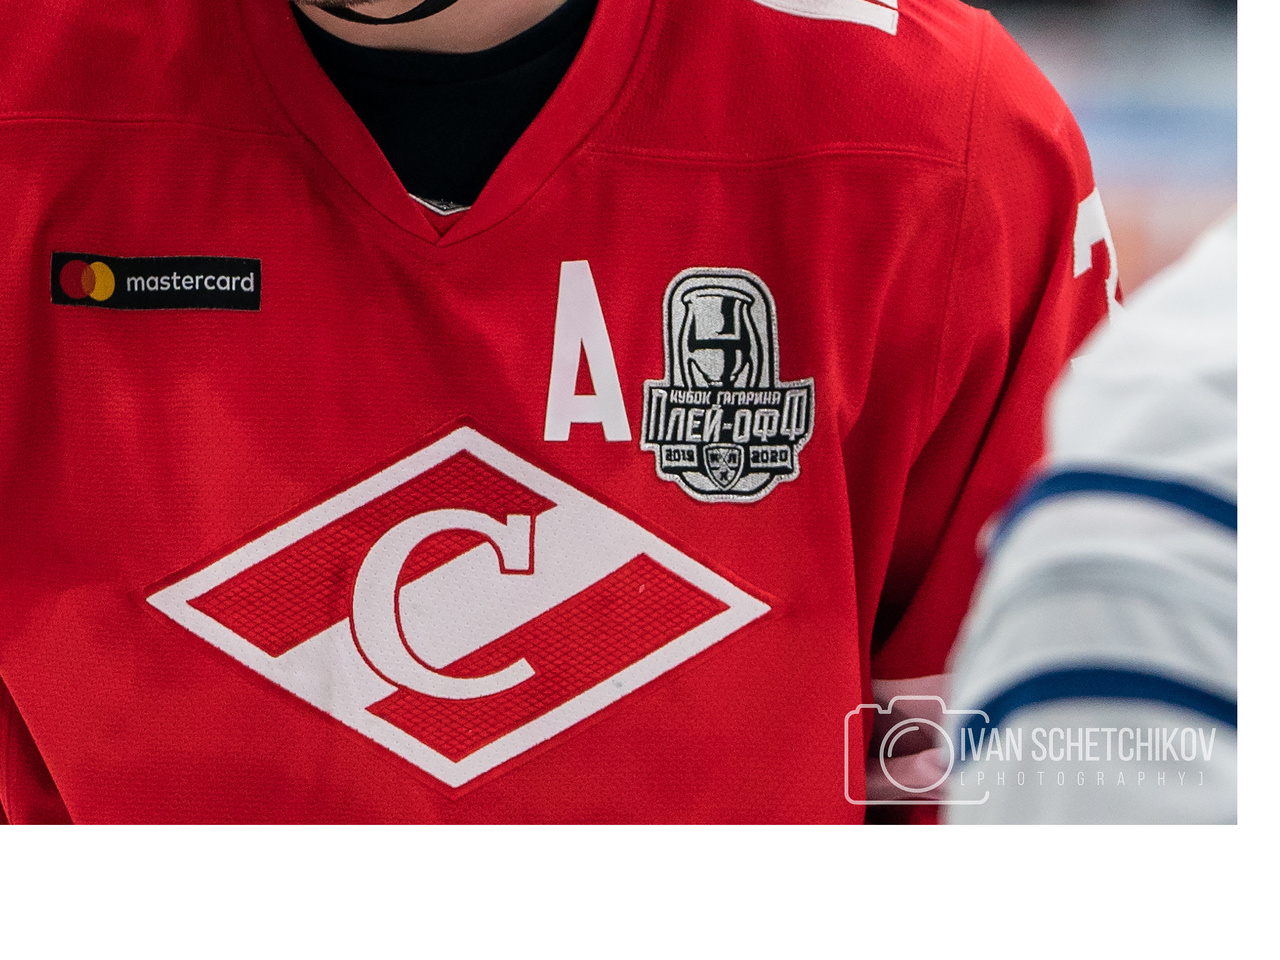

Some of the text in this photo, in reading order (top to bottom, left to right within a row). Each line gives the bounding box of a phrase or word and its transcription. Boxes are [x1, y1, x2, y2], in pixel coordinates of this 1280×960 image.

[126, 272, 255, 292] mastercard
[544, 260, 632, 441] A
[670, 390, 712, 405] КУБОК
[665, 448, 695, 463] 2019
[751, 449, 788, 464] 2020
